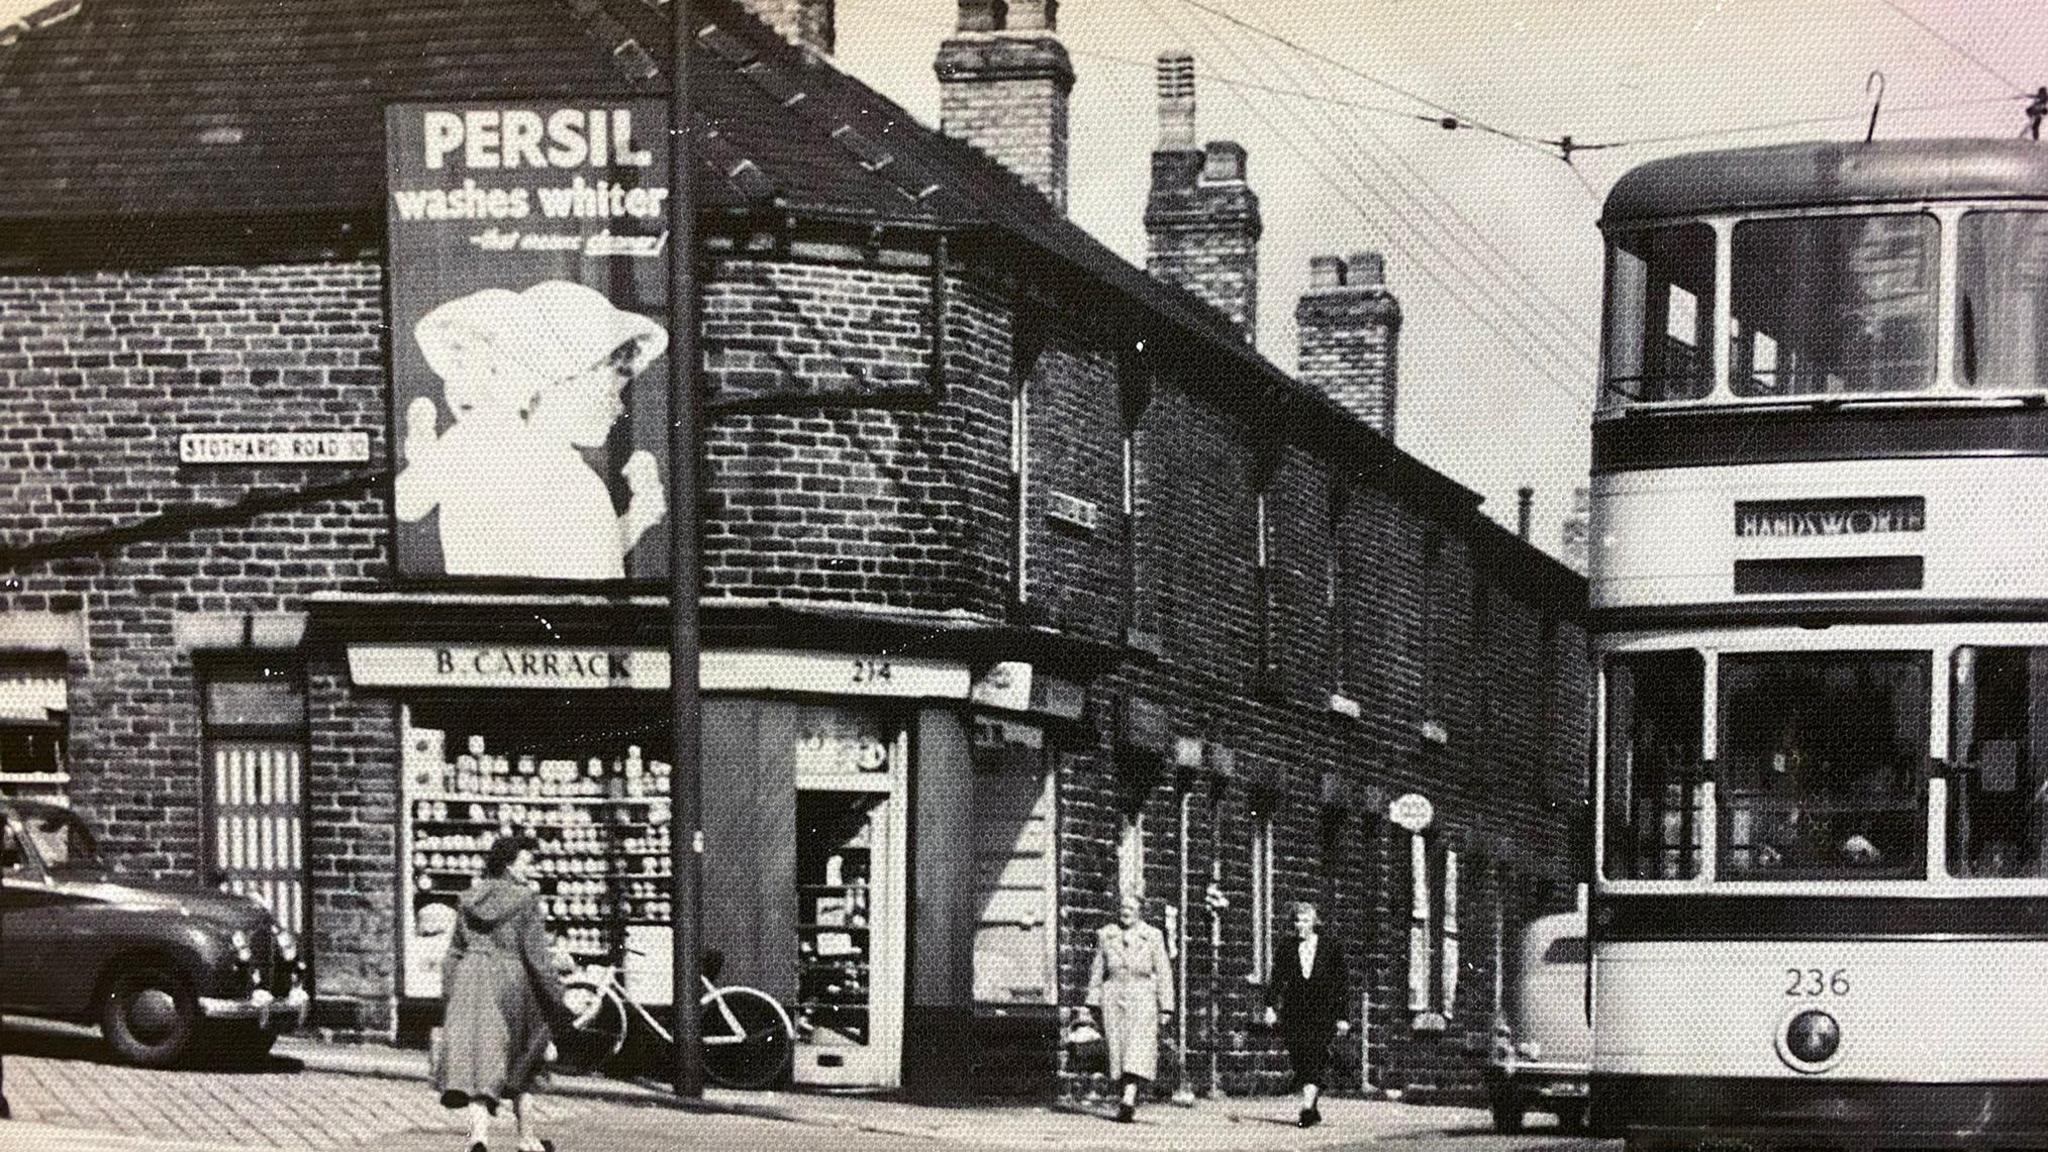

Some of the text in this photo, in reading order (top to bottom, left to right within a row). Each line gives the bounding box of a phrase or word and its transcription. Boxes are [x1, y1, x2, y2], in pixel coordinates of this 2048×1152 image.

[424, 109, 652, 168] PERSIL
[394, 176, 669, 220] washes whiter
[185, 439, 280, 457] STOTHARD
[291, 438, 337, 457] ROAD
[474, 650, 631, 679] CARRACK
[853, 660, 891, 683] 214
[1785, 968, 1850, 996] 236
